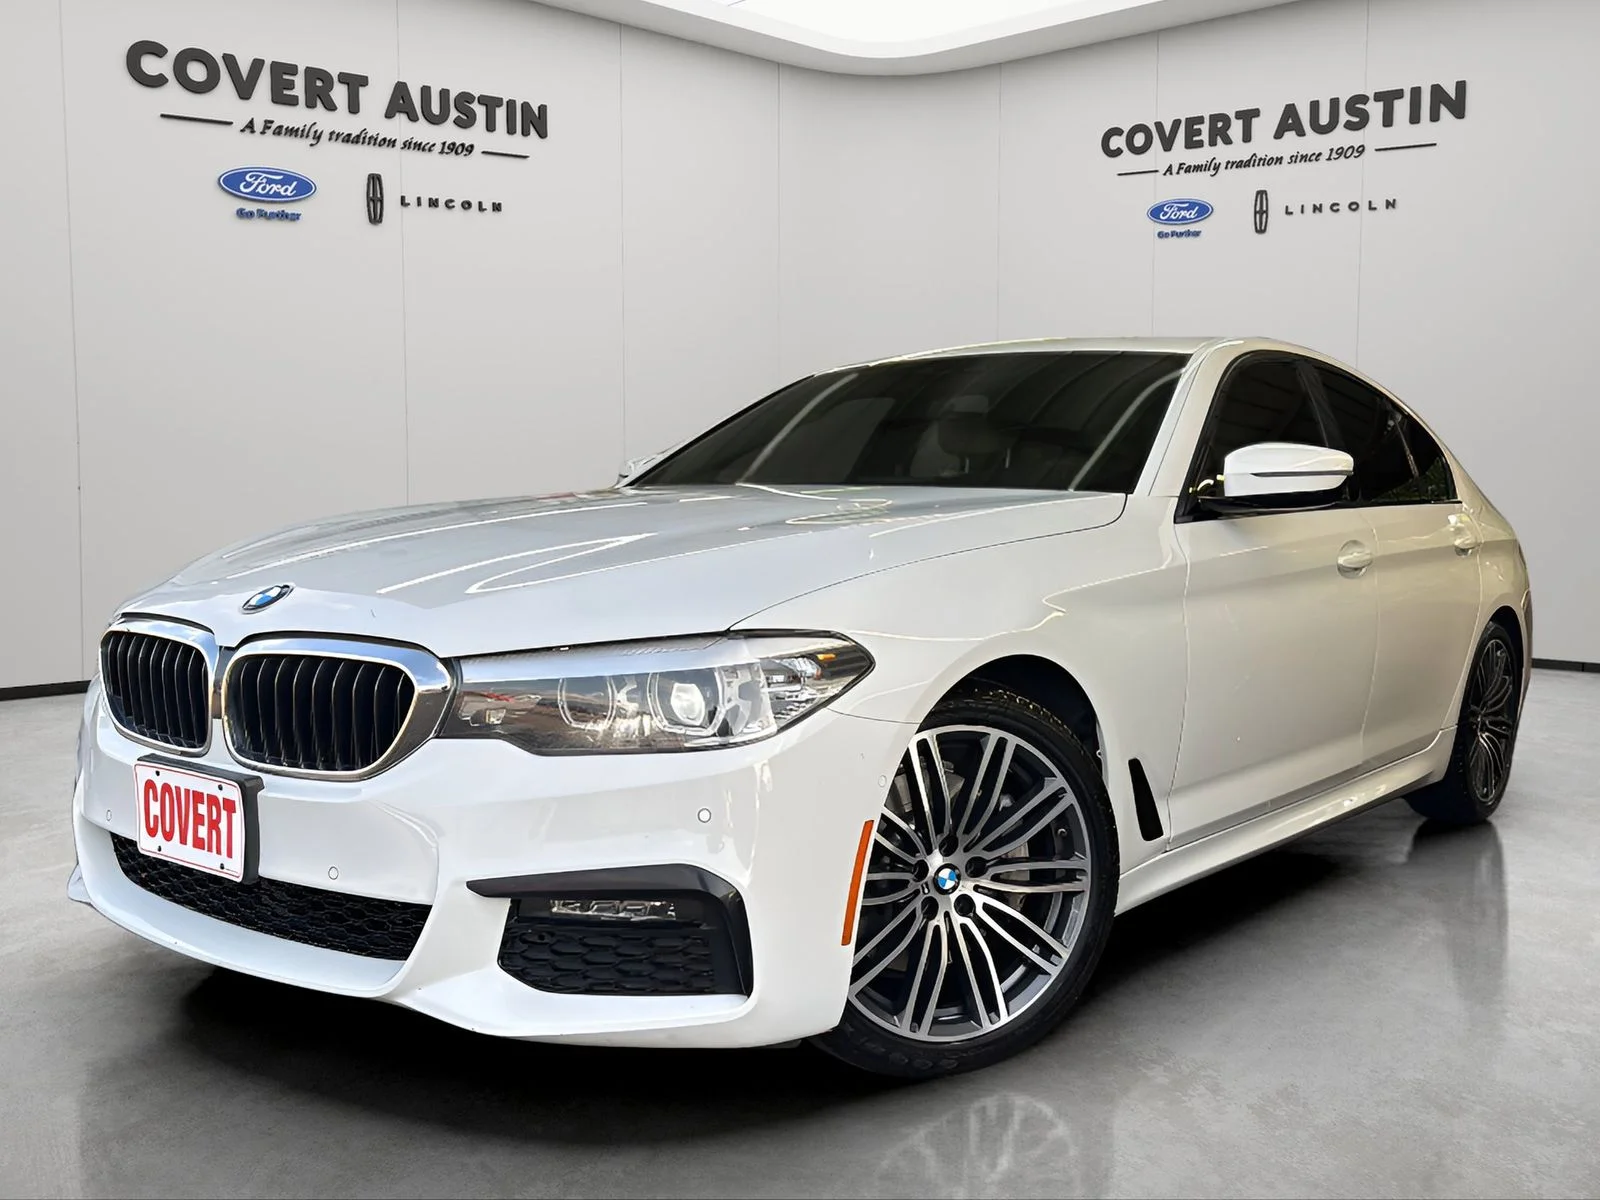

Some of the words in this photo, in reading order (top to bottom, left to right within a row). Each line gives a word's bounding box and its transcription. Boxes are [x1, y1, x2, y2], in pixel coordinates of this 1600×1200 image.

[126, 40, 369, 115] COVERT
[384, 80, 549, 140] AUSTIN
[1101, 107, 1261, 159] COVERT
[1273, 80, 1467, 141] AUSTIN
[240, 118, 257, 135] A
[260, 119, 323, 147] Family
[328, 127, 398, 149] tradition
[400, 136, 437, 153] since
[438, 141, 475, 157] 1909
[1163, 163, 1174, 177] A
[1176, 157, 1221, 178] Family
[1224, 152, 1284, 171] tradition
[1288, 150, 1323, 165] since
[1325, 144, 1366, 162] 1909
[240, 172, 298, 197] Ford
[400, 195, 503, 214] LINCOLN
[1160, 203, 1200, 220] Ford
[1284, 197, 1398, 216] LINCOLN
[144, 779, 236, 859] COVERT
